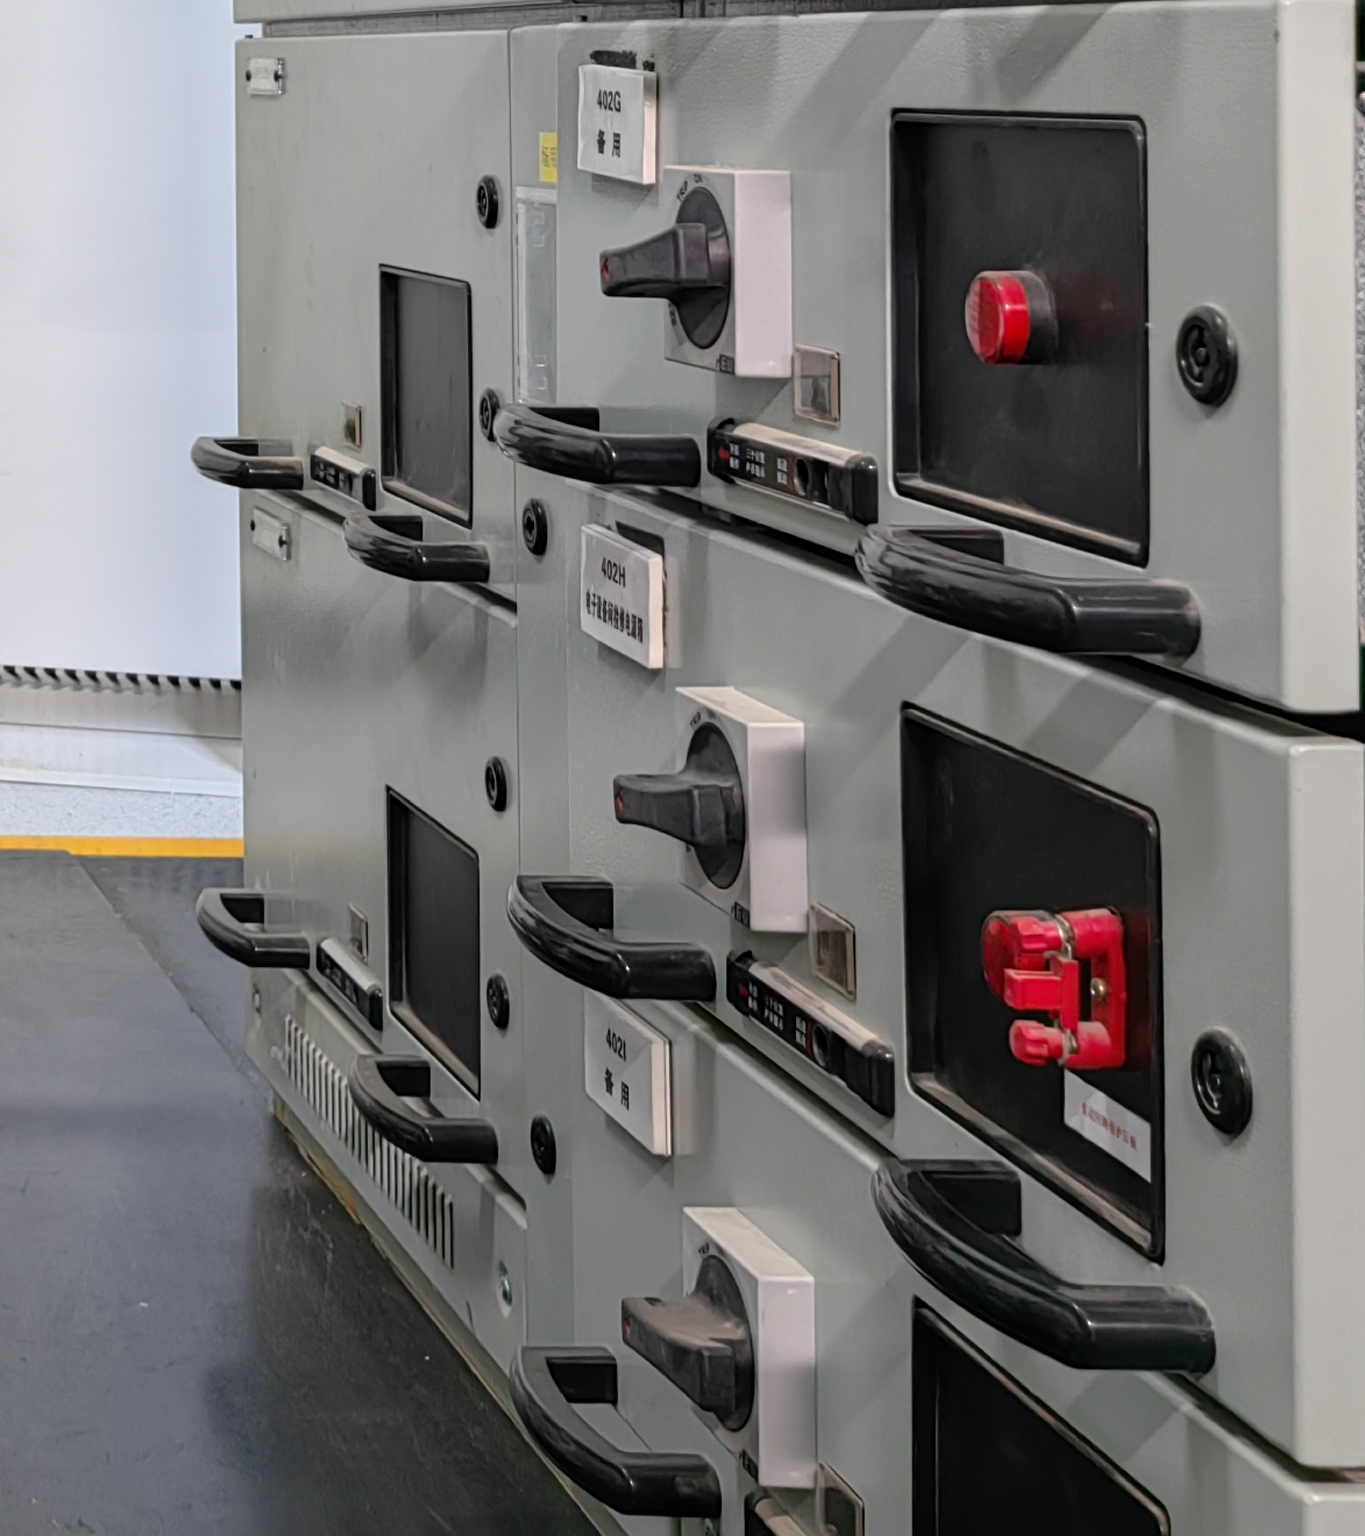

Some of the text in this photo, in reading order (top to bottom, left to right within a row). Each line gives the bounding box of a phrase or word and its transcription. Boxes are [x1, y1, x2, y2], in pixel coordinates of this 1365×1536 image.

[597, 89, 621, 113] 402G
[597, 128, 621, 158] 备用
[601, 557, 626, 587] 402H
[605, 1067, 630, 1111] 备用
